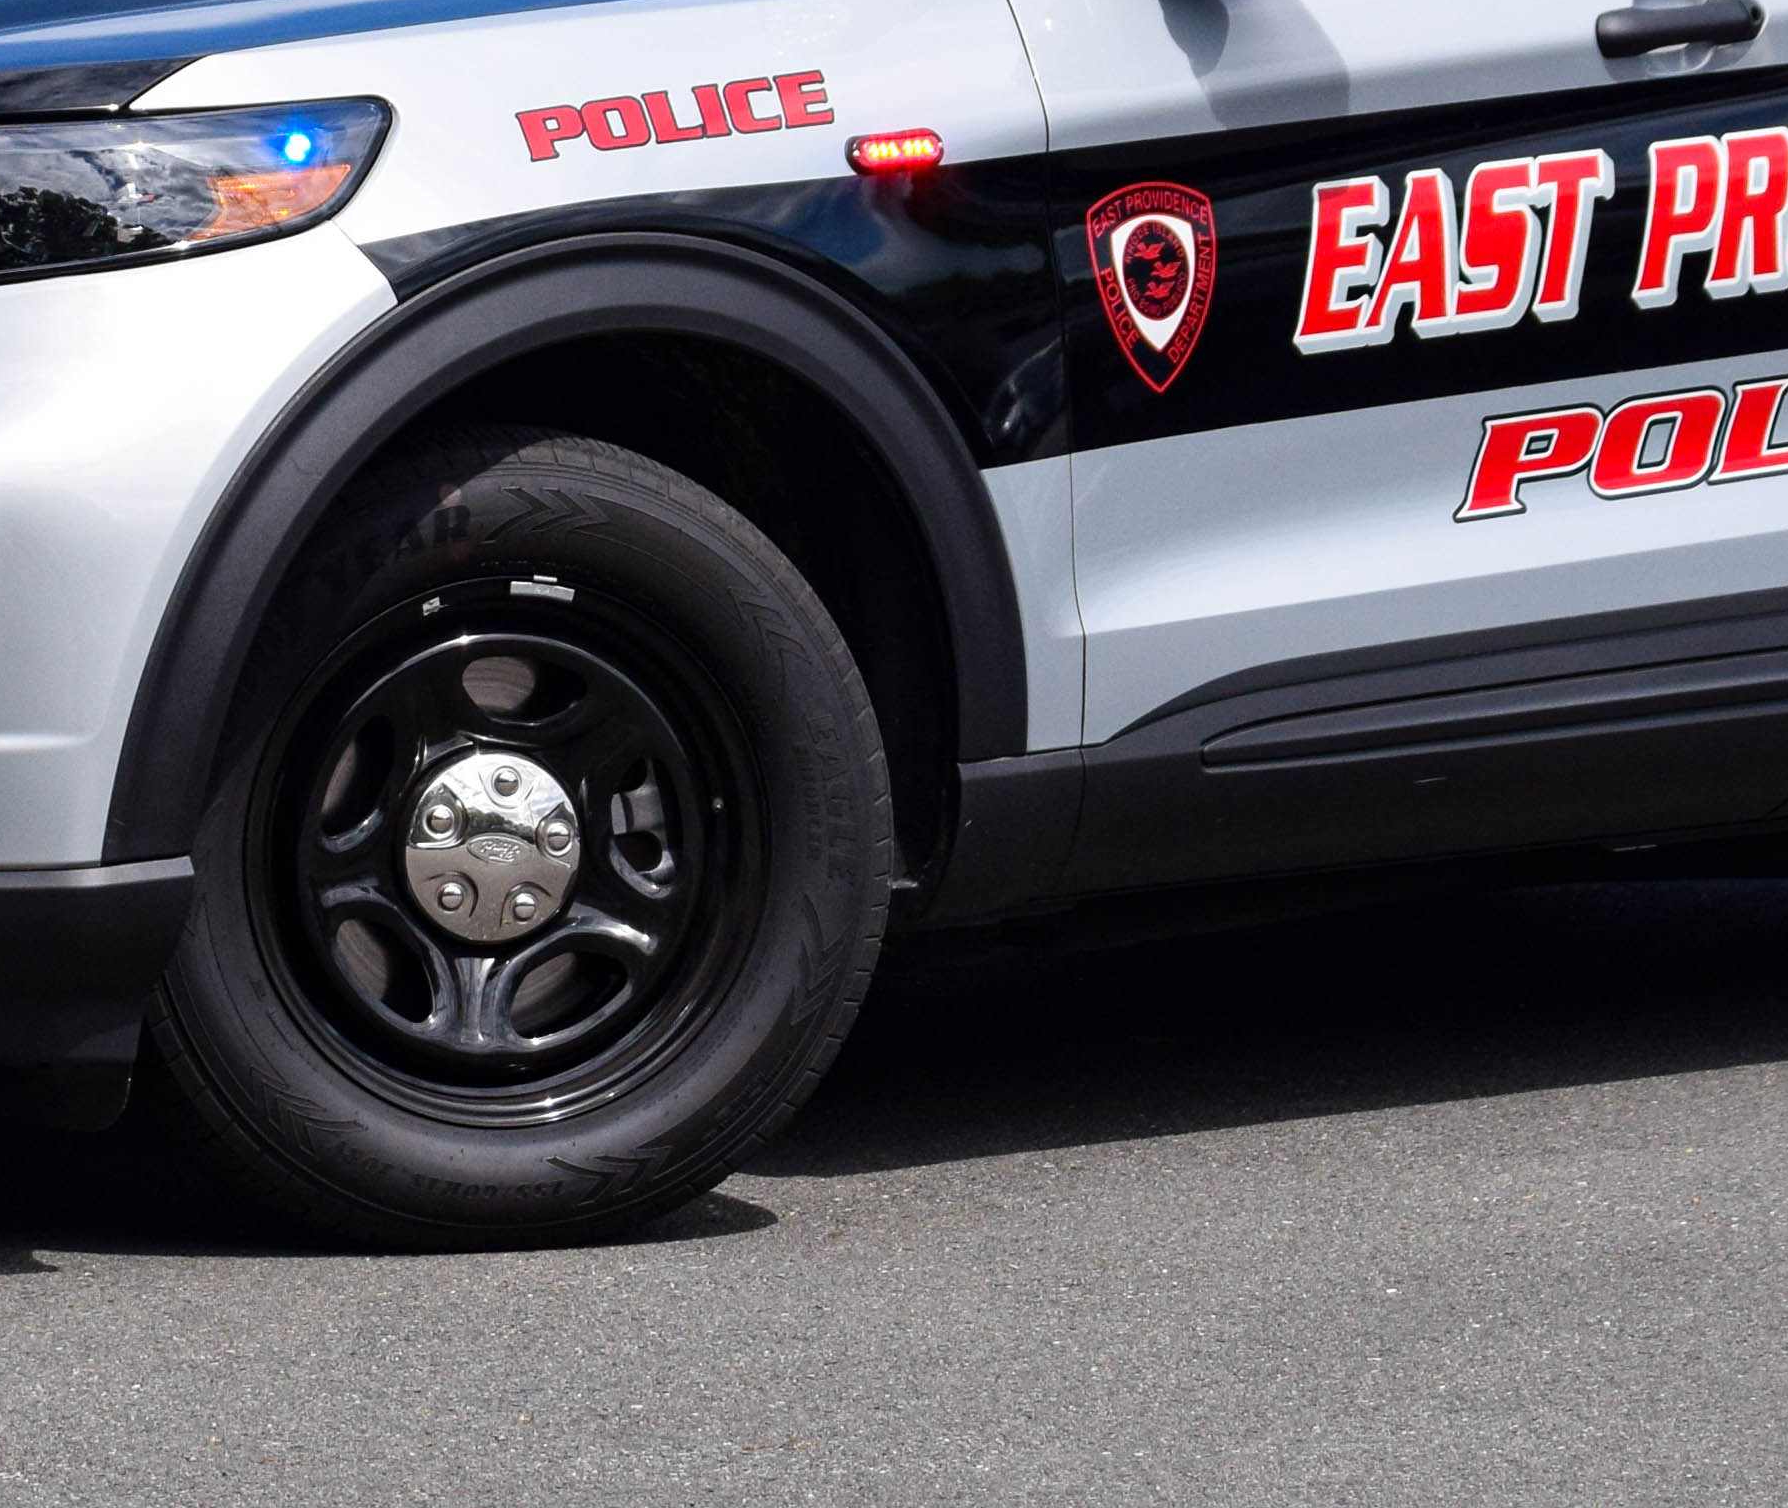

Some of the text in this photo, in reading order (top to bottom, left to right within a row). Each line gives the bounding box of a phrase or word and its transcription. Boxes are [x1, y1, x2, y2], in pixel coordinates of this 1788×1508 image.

[515, 69, 835, 162] POLICE
[1091, 190, 1210, 239] EAST PROVIDENCE
[1293, 148, 1614, 354] EAST
[1099, 266, 1140, 350] POLICE
[1166, 231, 1212, 364] DEPARTMENT
